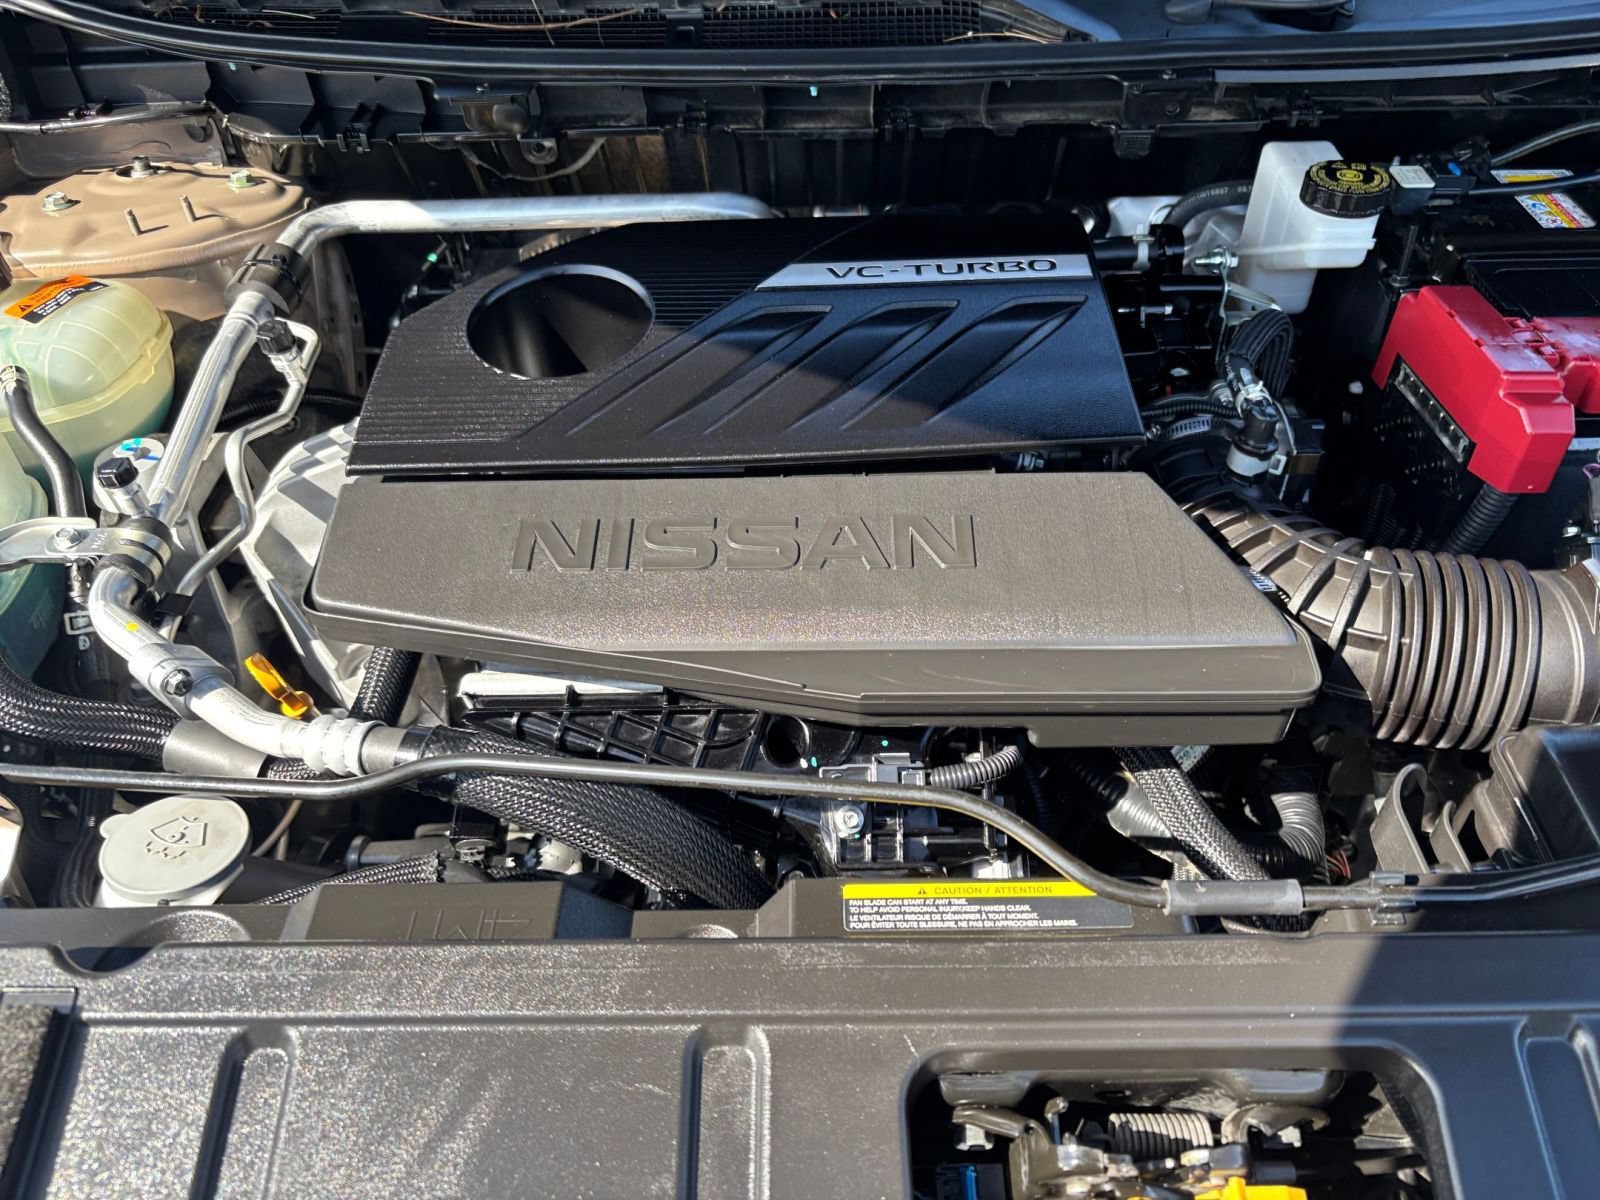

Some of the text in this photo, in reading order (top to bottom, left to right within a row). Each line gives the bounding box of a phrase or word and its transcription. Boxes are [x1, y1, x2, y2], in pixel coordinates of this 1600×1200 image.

[826, 259, 1058, 279] VC-TURBO
[509, 514, 978, 573] NISSAN
[934, 886, 982, 895] CAUTION
[994, 886, 1052, 894] ATTENTION
[905, 913, 931, 921] RISQUE
[942, 912, 980, 920] DÉMARRER
[871, 920, 895, 928] ÉVITER
